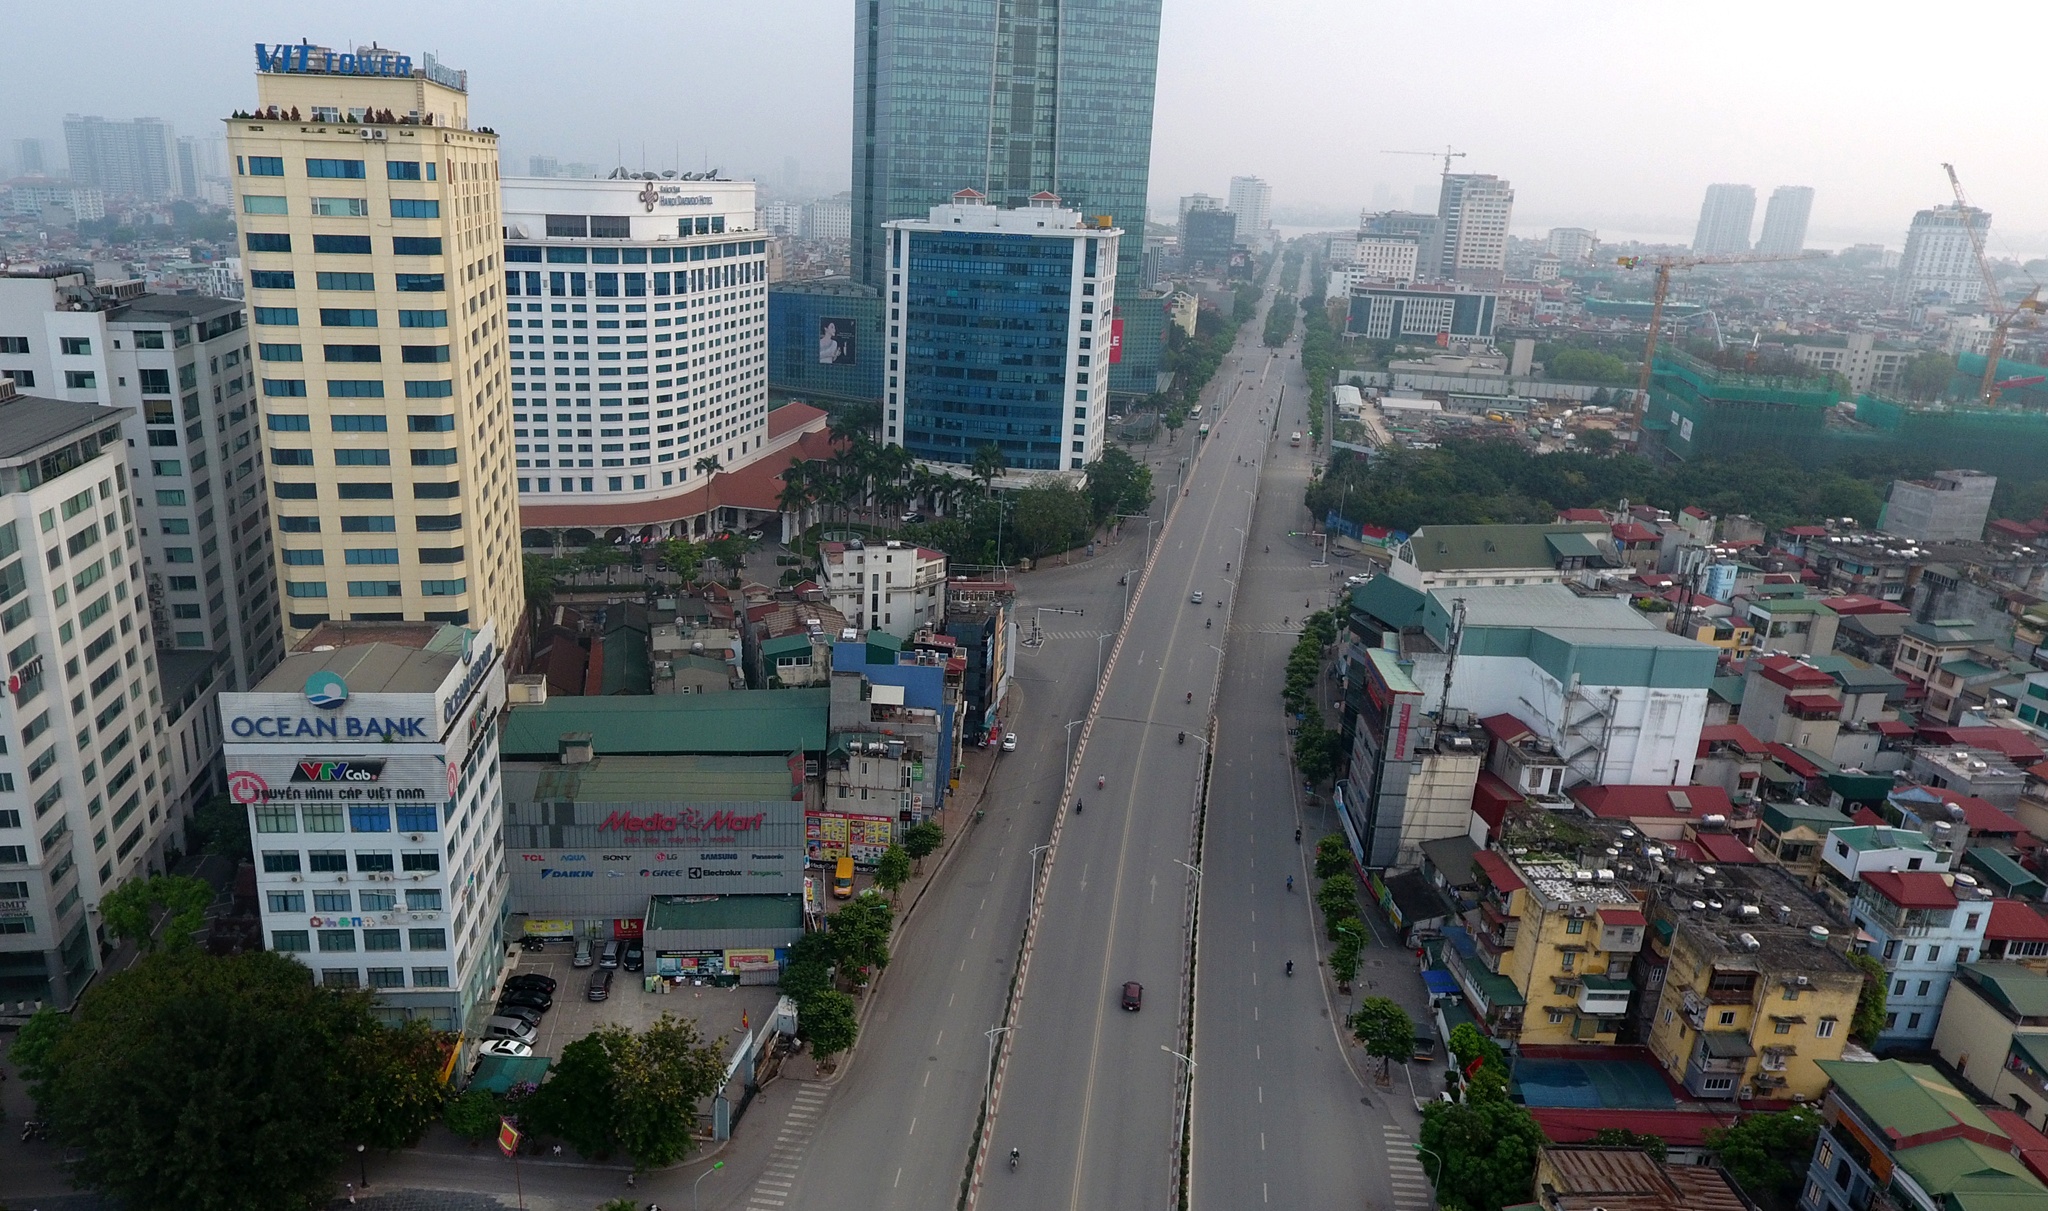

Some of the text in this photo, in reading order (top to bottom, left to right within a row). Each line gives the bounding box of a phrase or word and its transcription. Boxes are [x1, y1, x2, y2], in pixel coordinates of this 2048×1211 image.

[255, 43, 317, 72] VIT
[323, 52, 411, 77] TOWER
[231, 716, 427, 737] OCEAN BANK
[599, 810, 764, 832] Media Mart
[552, 870, 594, 878] DAIKIN
[652, 869, 683, 877] GREE
